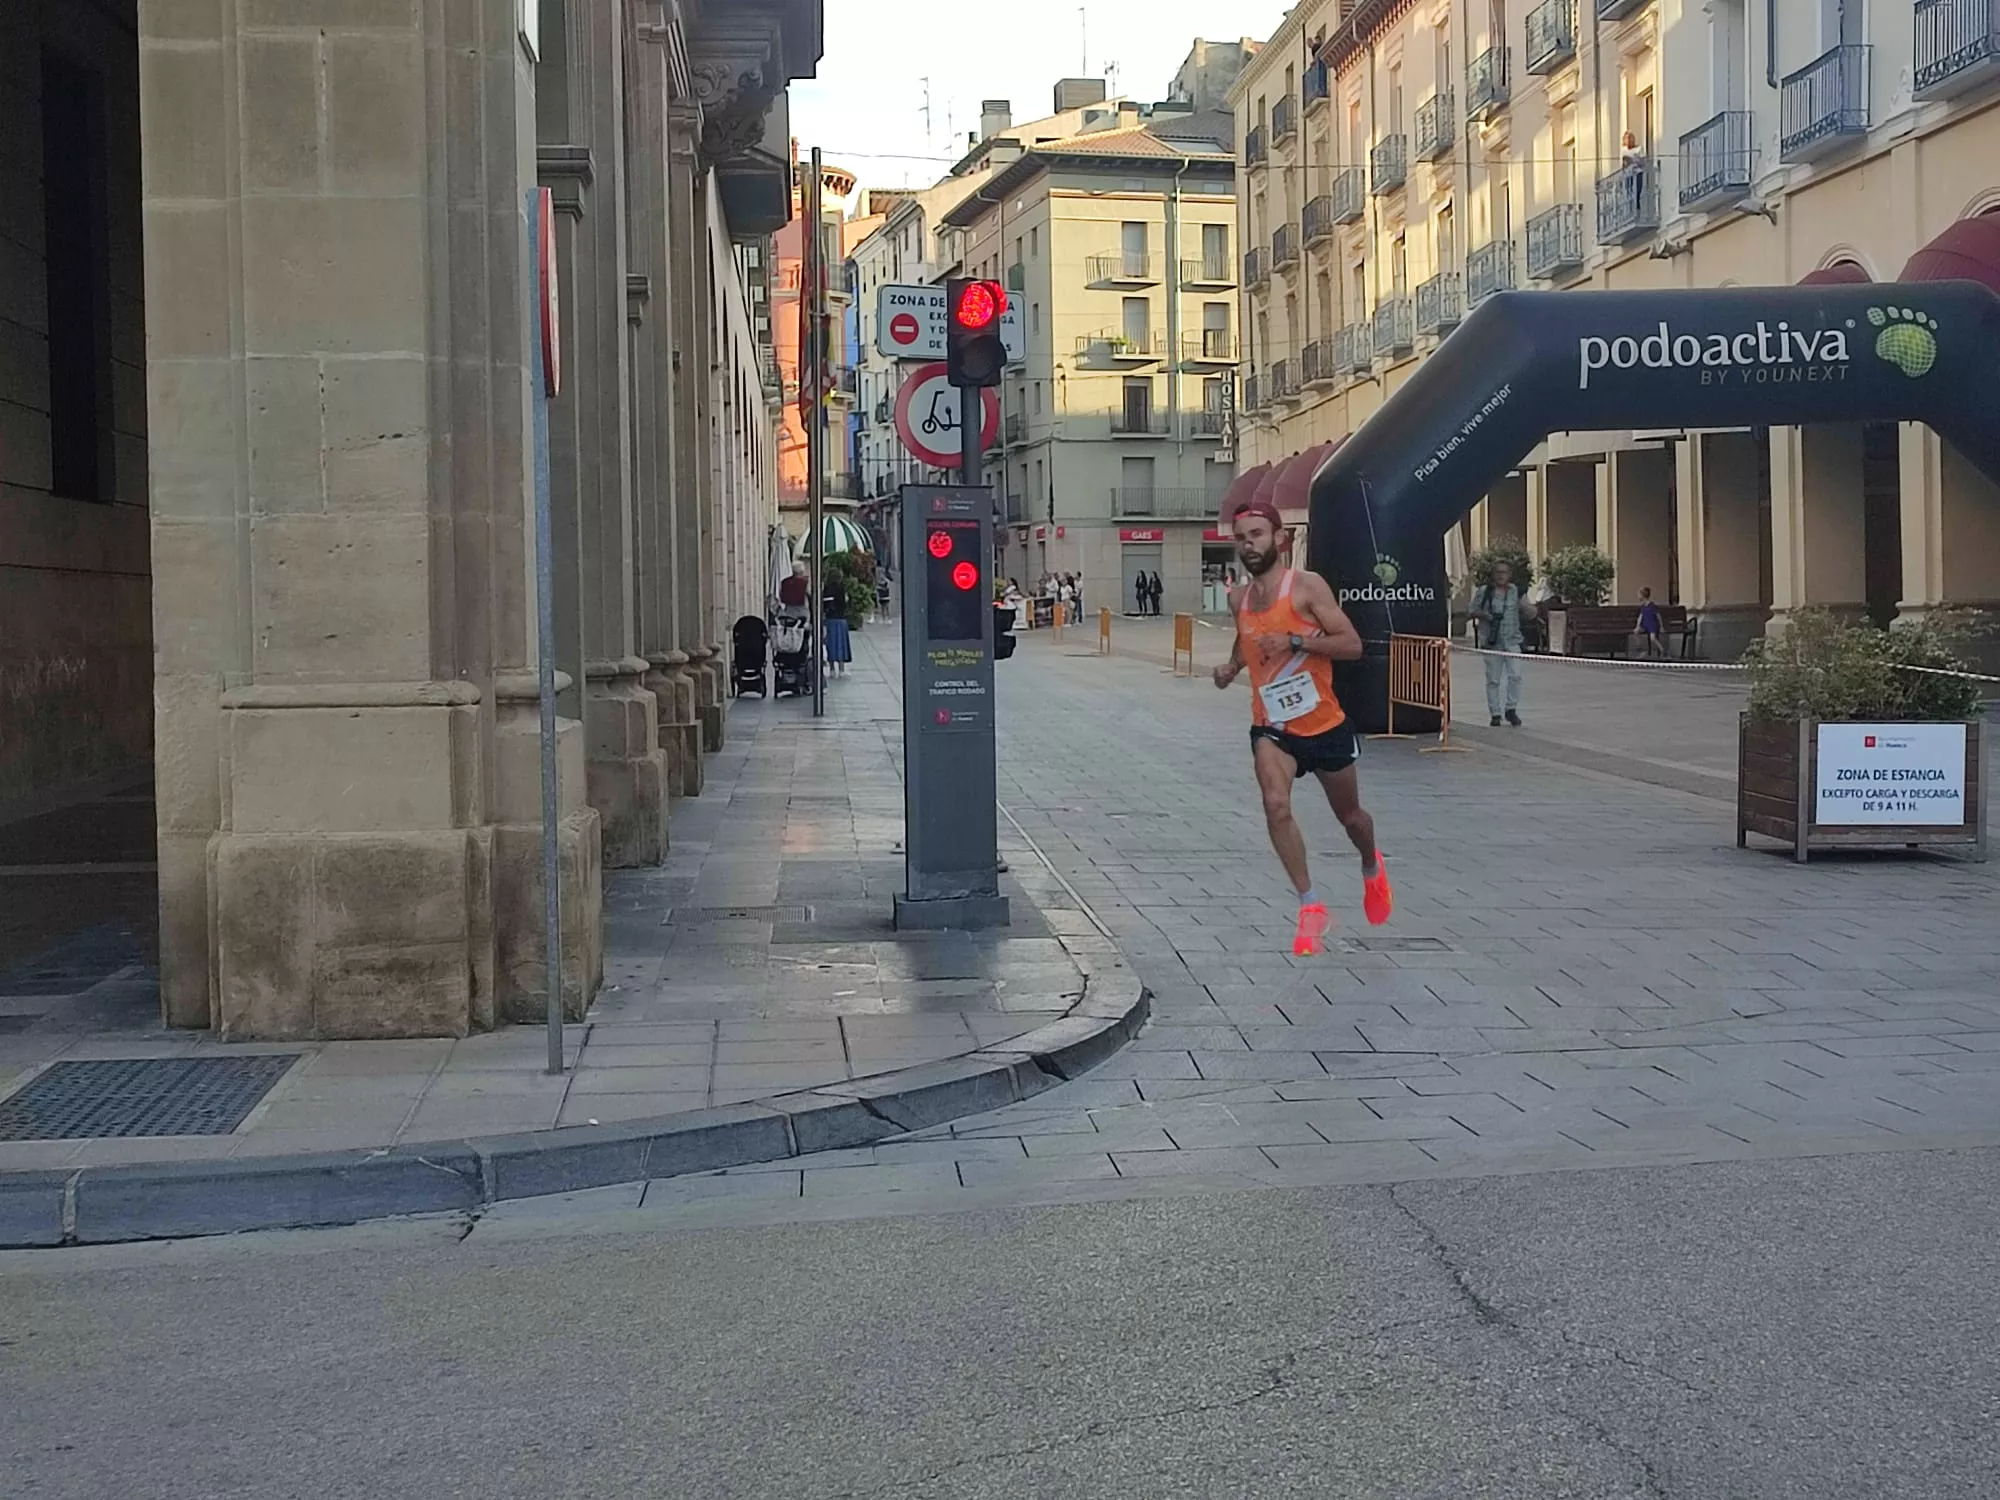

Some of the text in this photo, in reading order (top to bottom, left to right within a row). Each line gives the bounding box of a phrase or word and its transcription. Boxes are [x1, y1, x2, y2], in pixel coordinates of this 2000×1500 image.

[890, 294, 946, 307] ZONA DE
[930, 326, 936, 334] Y
[929, 340, 942, 348] DE
[1579, 321, 1850, 389] podoactiva
[1700, 364, 1850, 385] BY YOUNEXT
[1221, 370, 1233, 448] HOSTAL
[1414, 383, 1512, 482] Pisa bien, vive mejor
[1339, 582, 1435, 608] podoactiva
[934, 680, 965, 688] CONTROL
[1277, 691, 1303, 709] 133
[1836, 769, 1945, 781] ZONA DE ESTANCIA
[1822, 788, 1959, 799] EXCEPTO CARGA Y DESCARGA
[1863, 801, 1918, 811] DE 9 A 11 H.
